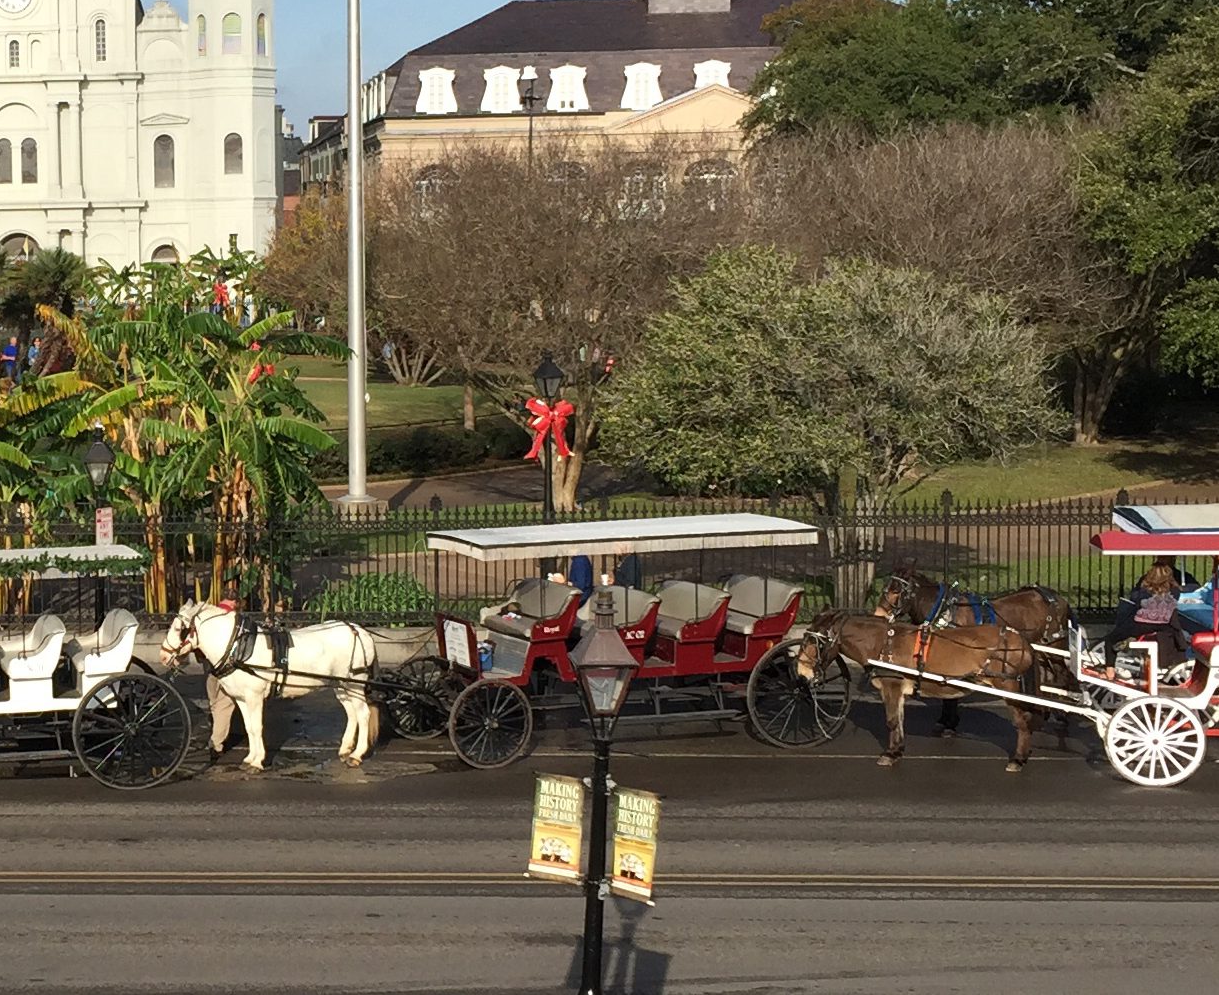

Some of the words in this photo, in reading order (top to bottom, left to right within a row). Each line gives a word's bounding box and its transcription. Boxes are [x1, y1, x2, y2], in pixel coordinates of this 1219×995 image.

[541, 780, 579, 799] MAKING
[539, 794, 579, 812] HISTORY
[618, 795, 656, 814] MAKING
[538, 808, 558, 820] FRESH
[559, 811, 577, 822] DAILY
[618, 809, 654, 828] HISTORY
[616, 823, 635, 835] FRESH
[635, 826, 652, 838] DAILY
